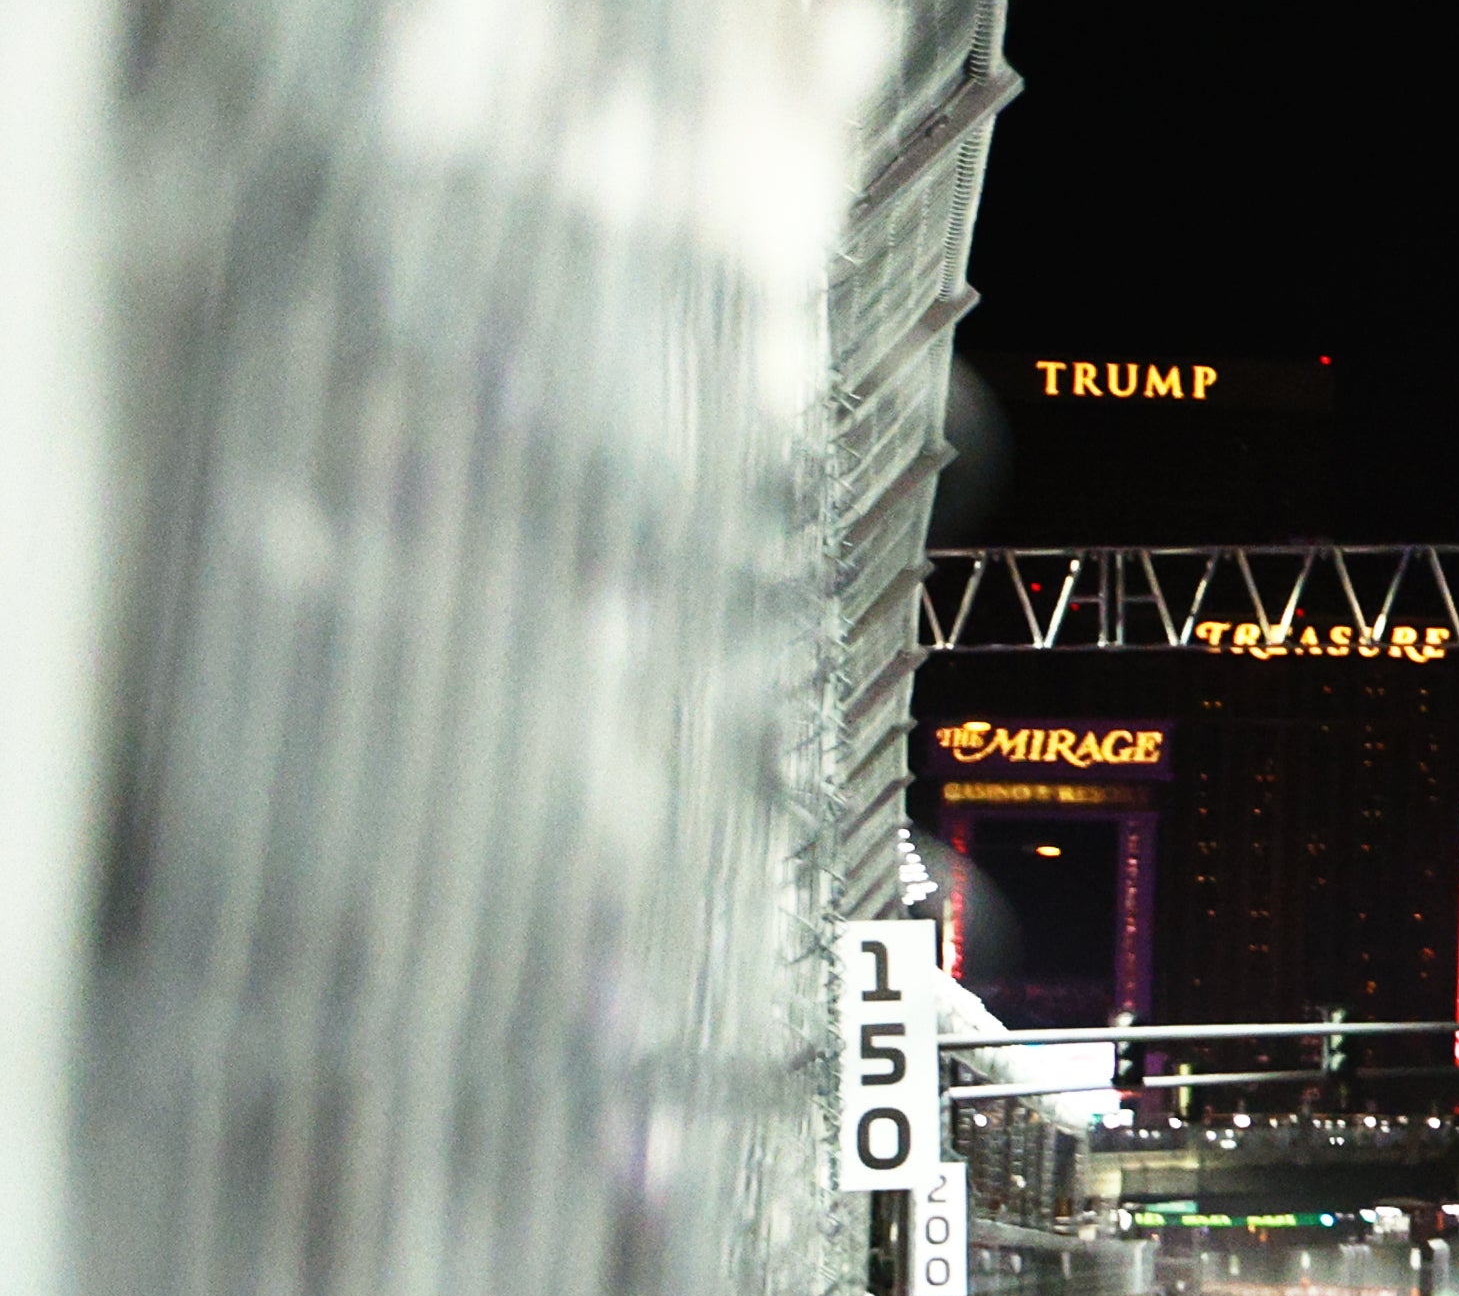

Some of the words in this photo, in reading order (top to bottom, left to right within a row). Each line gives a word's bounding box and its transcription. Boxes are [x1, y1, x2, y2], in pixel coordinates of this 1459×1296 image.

[1036, 360, 1218, 399] TRUMP
[954, 726, 1164, 768] MIRAGE
[856, 940, 912, 1171] 150
[924, 1175, 950, 1286] 200
